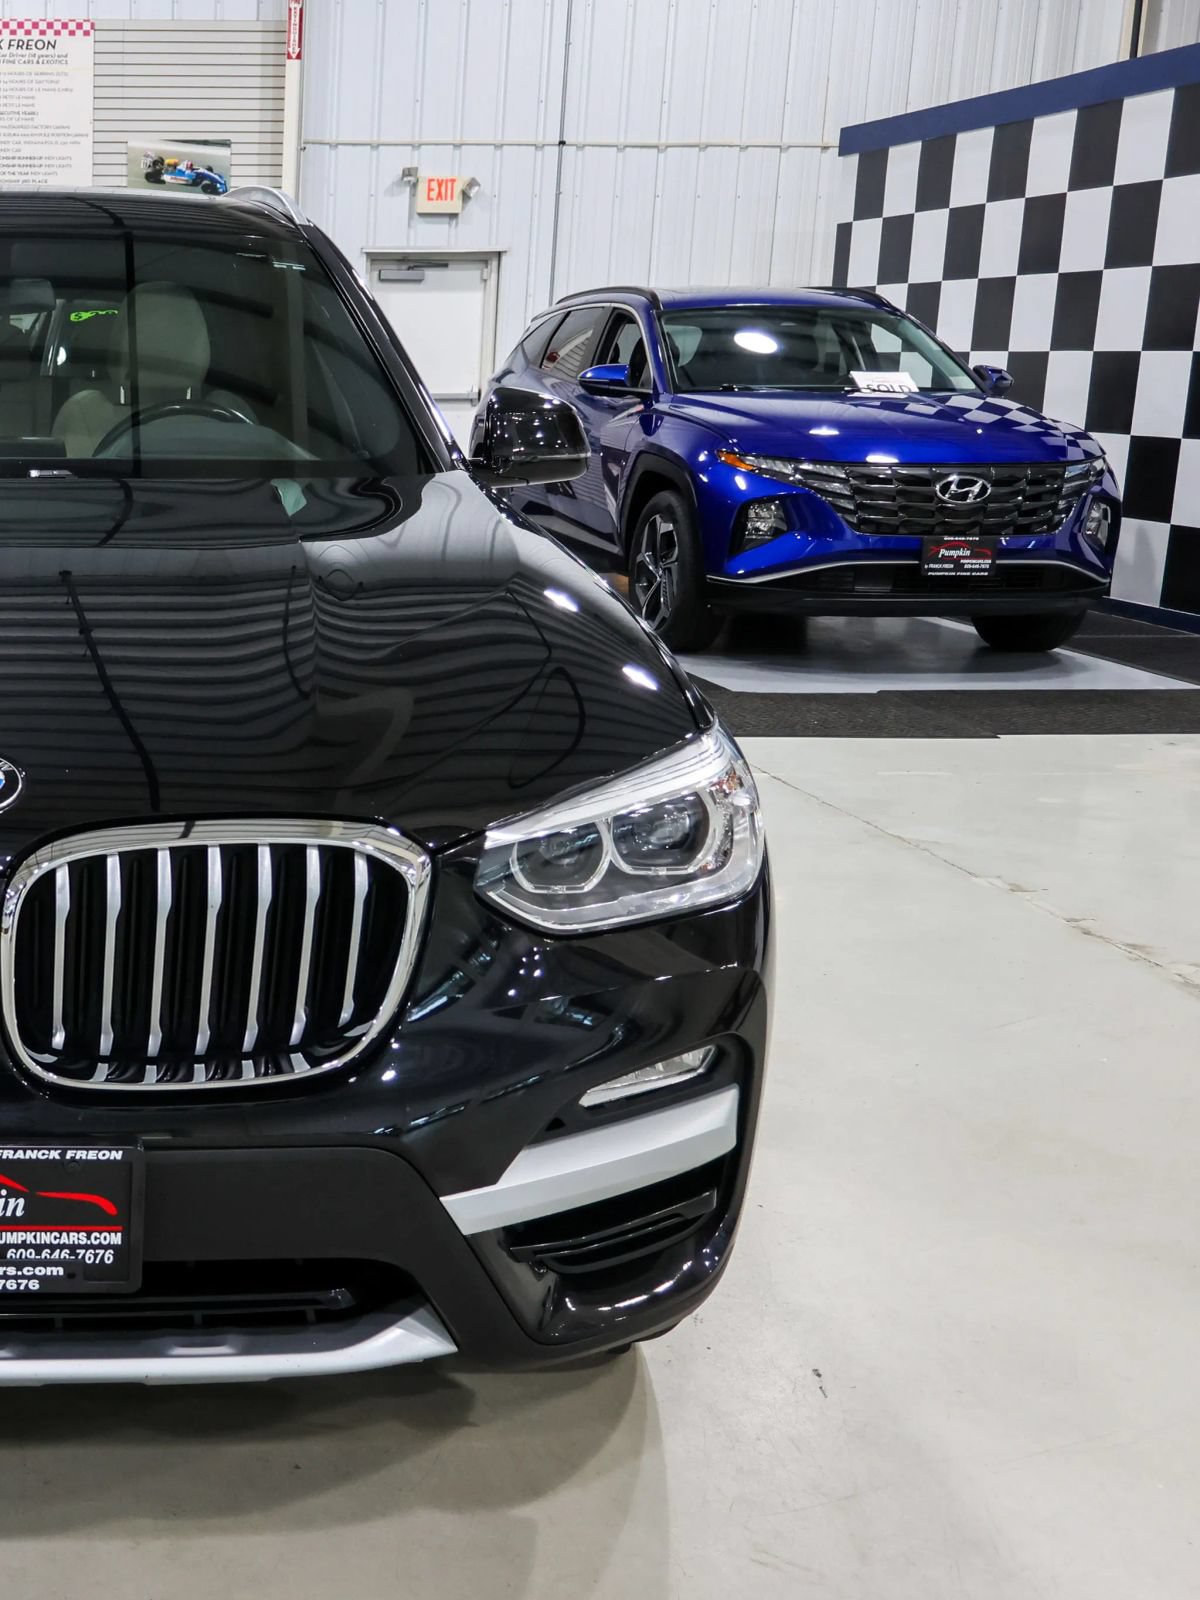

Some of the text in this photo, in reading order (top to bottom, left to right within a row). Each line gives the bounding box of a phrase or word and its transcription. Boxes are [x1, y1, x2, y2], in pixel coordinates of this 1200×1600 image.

[8, 39, 57, 50] FREON
[426, 178, 457, 202] EXIT
[938, 548, 971, 558] Pumpkin
[65, 1150, 123, 1160] FREON
[6, 1248, 115, 1264] 609-646-7676
